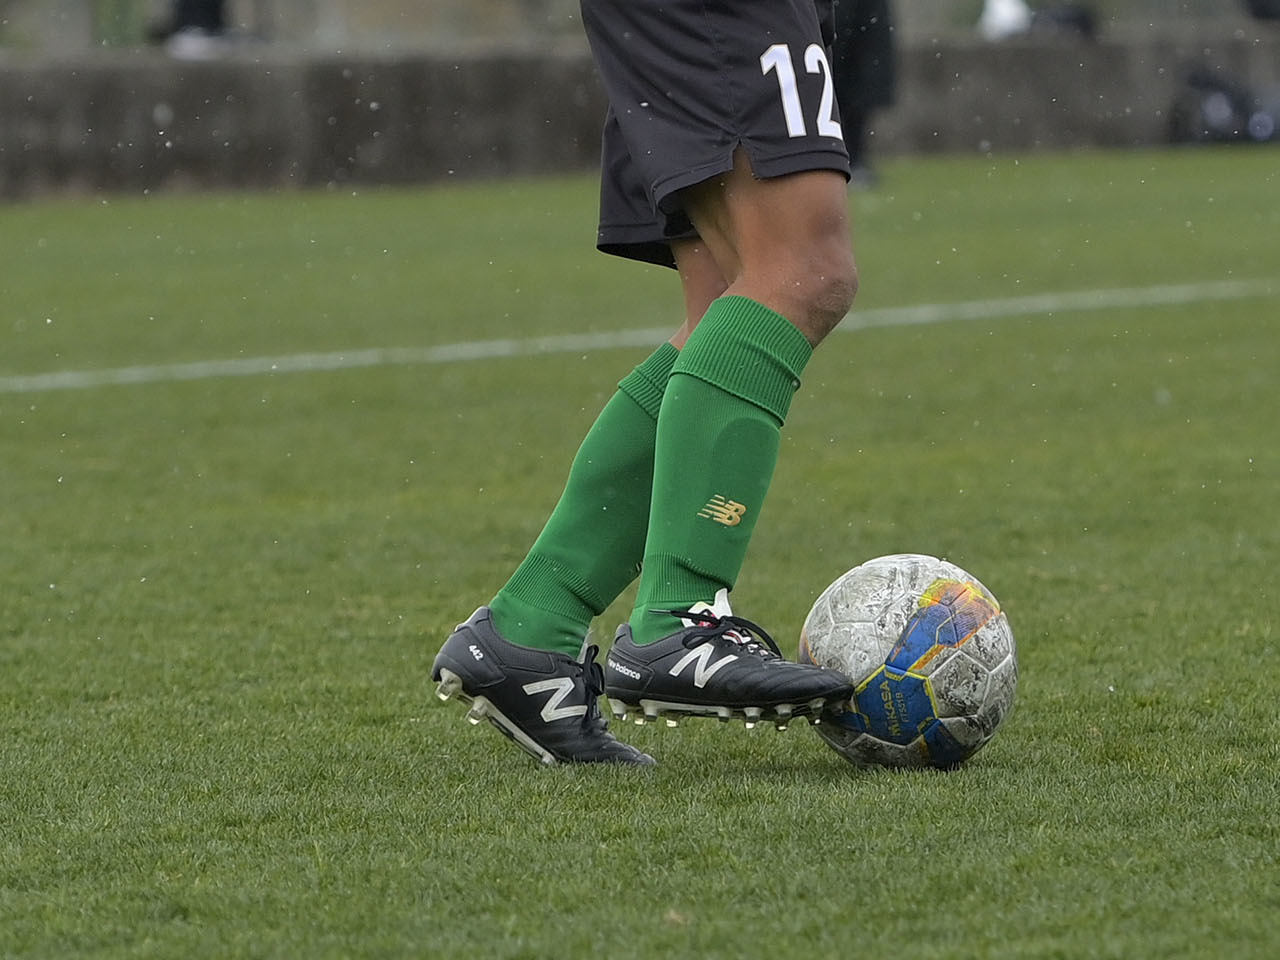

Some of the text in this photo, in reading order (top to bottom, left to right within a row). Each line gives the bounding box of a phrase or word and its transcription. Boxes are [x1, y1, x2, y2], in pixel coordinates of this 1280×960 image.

[760, 44, 843, 140] 12
[468, 645, 484, 661] 442
[615, 662, 641, 680] balance
[879, 680, 901, 736] MIKASA
